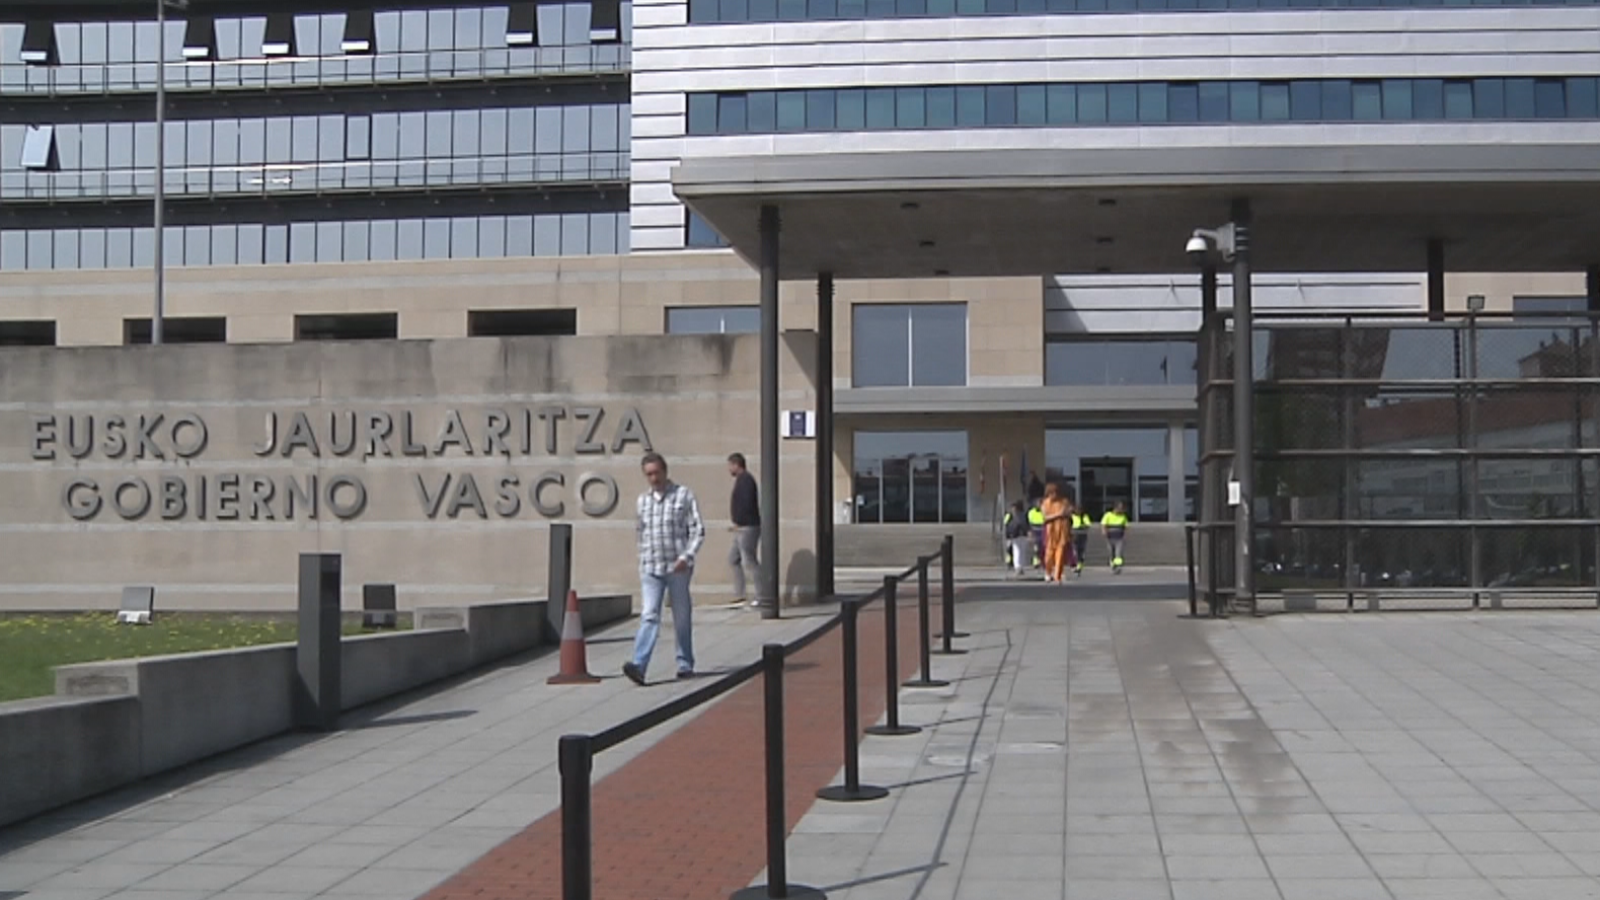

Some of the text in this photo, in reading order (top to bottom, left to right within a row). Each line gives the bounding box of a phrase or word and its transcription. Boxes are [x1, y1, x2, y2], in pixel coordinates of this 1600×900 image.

[32, 405, 653, 461] EUSKO JAURLARITZA
[66, 470, 619, 520] GOBIERNO VASCO
